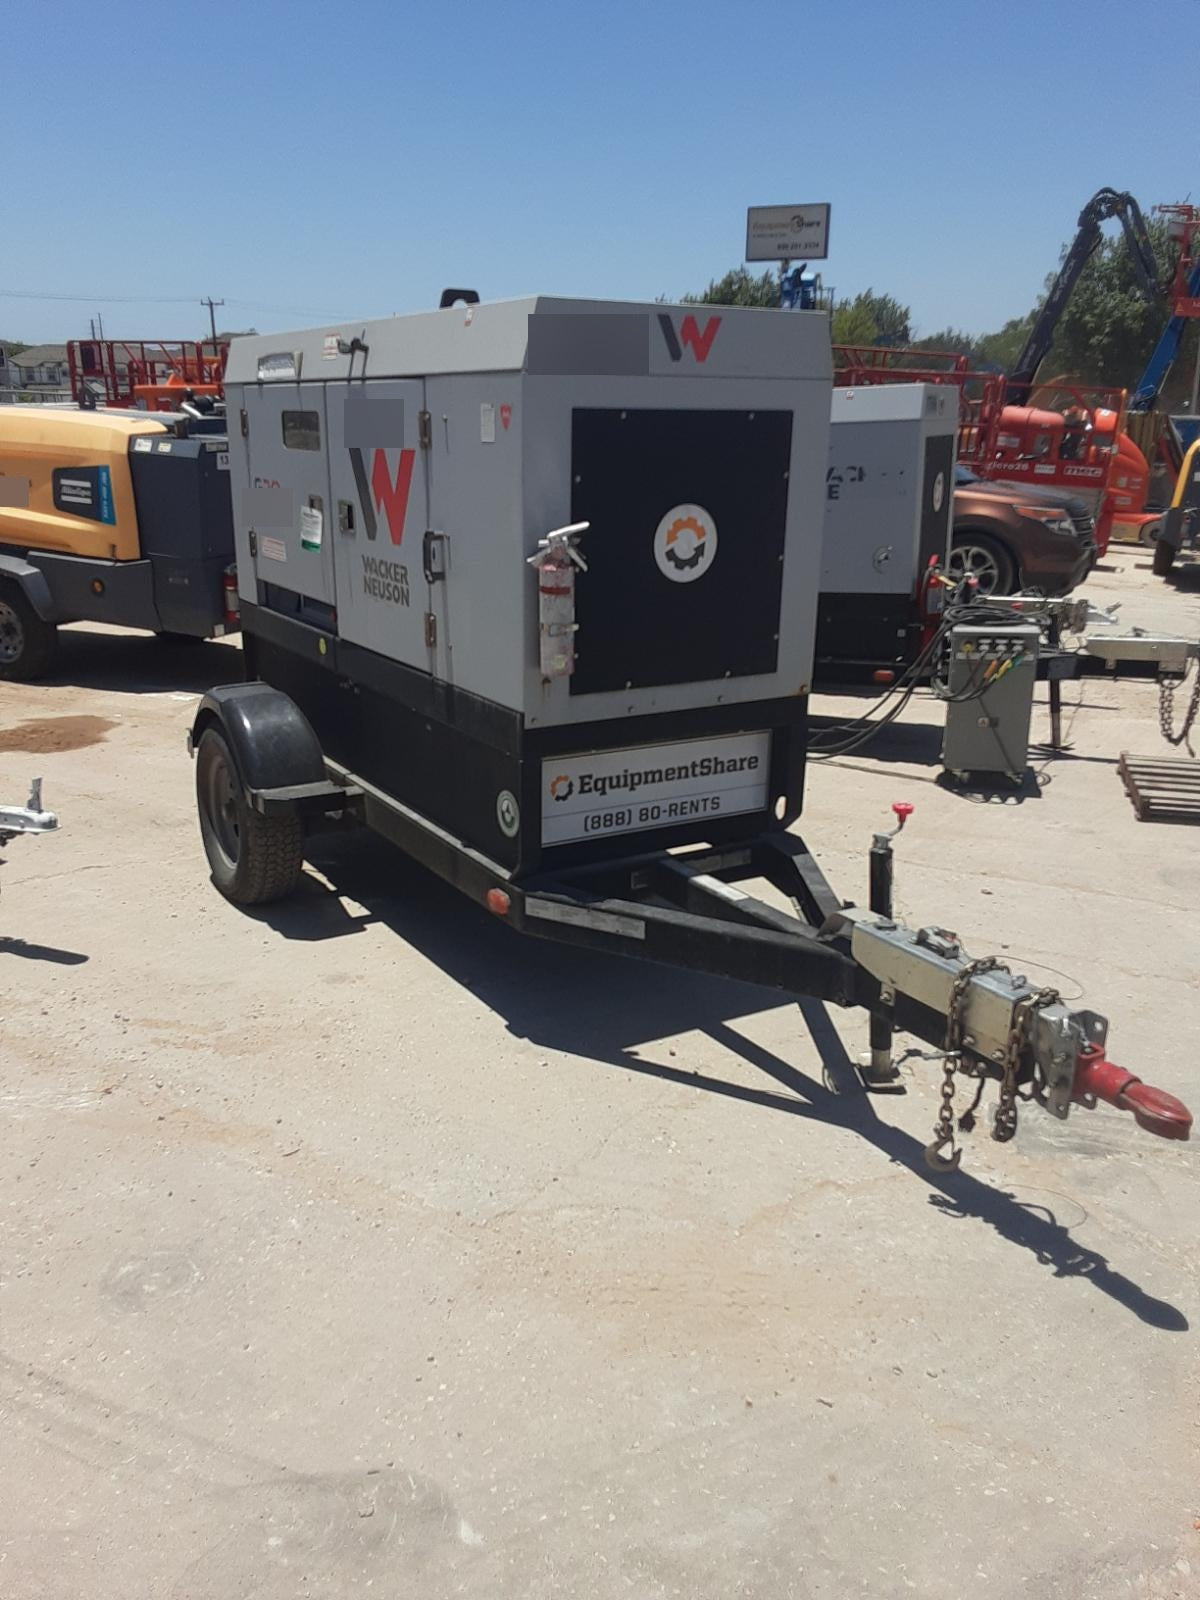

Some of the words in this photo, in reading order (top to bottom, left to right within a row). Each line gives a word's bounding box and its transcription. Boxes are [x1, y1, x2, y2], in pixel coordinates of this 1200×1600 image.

[361, 554, 410, 586] WACKER
[363, 574, 411, 608] NEUSON
[578, 754, 759, 796] EquipmentShare
[584, 809, 632, 832] (888)
[638, 796, 721, 823] 80-RENTS
